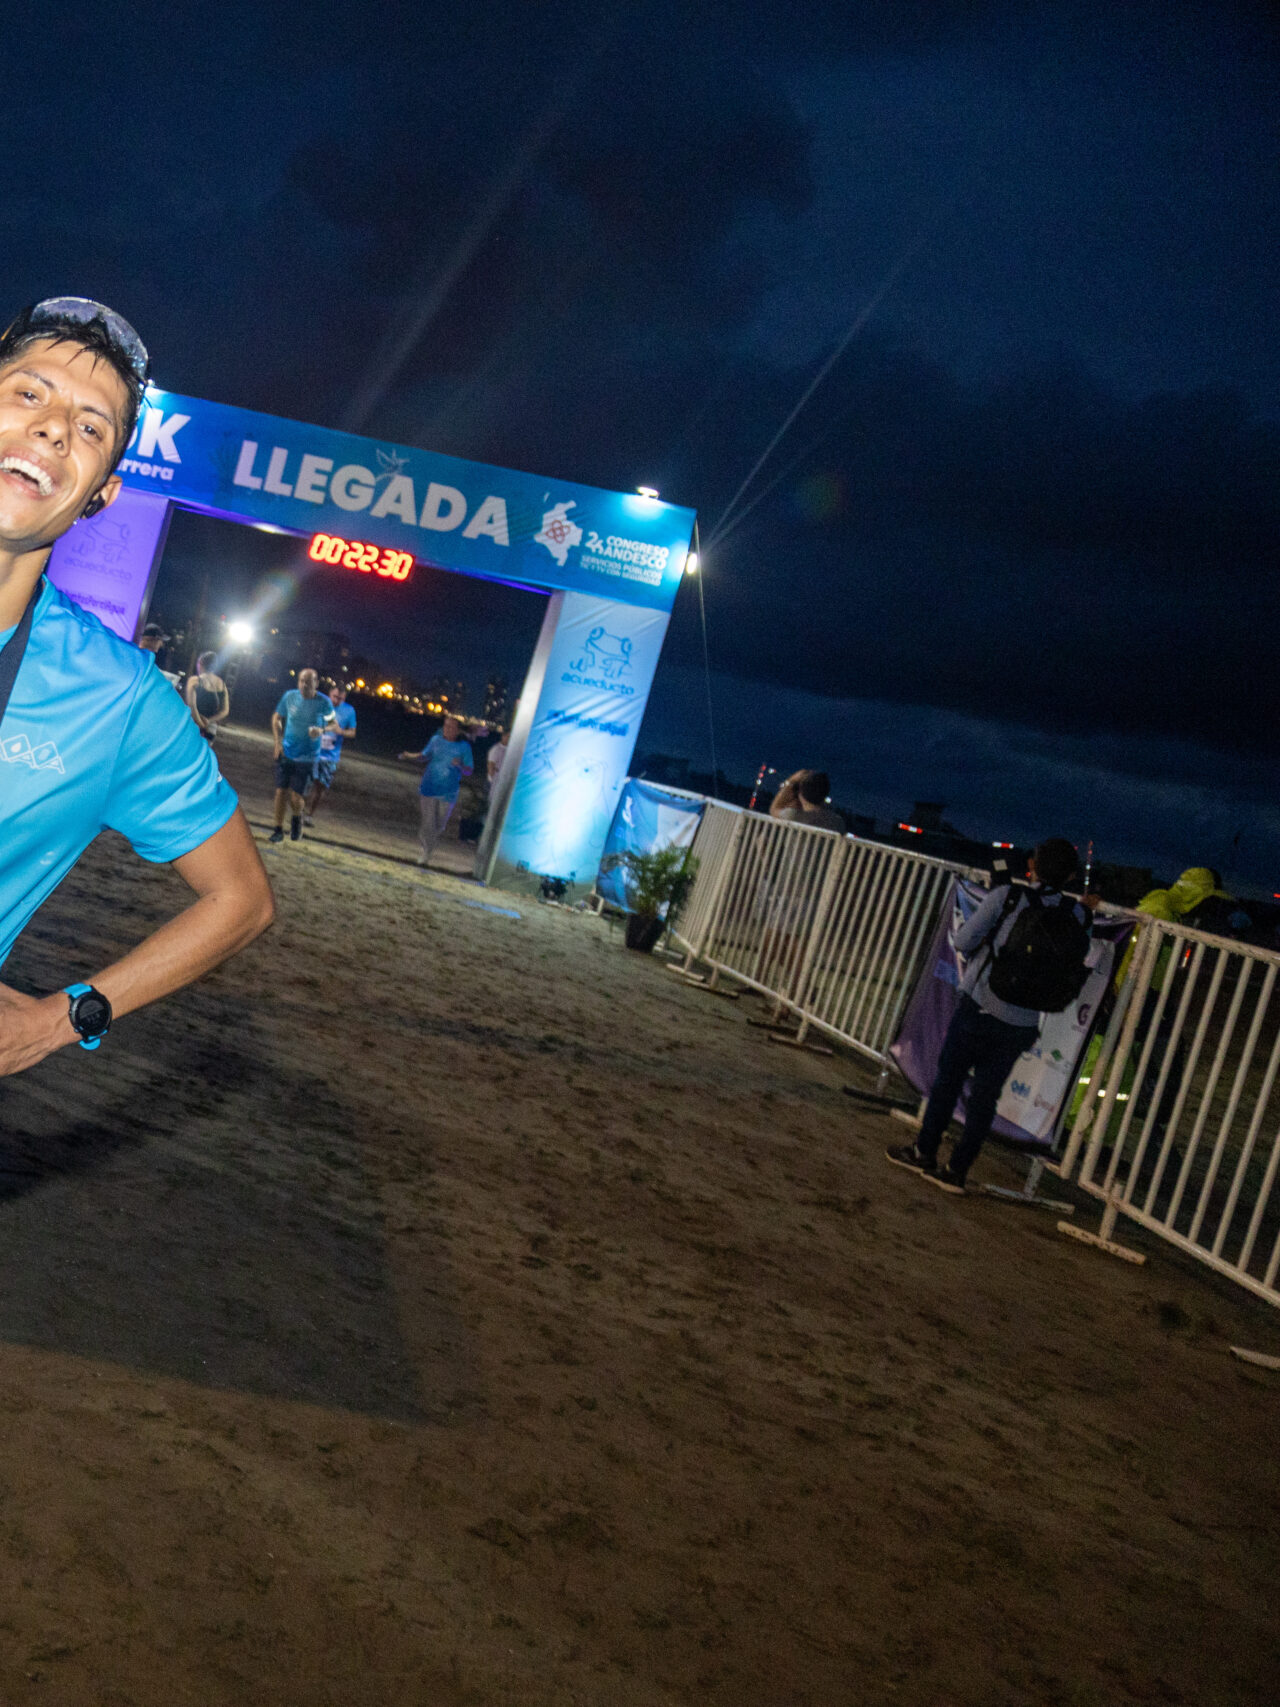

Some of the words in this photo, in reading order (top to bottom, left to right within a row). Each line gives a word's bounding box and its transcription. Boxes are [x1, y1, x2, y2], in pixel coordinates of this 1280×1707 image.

[126, 408, 191, 464] K
[233, 440, 510, 547] LLEGADA
[604, 547, 667, 570] ANDESCO
[606, 536, 669, 558] CONGRESO
[561, 672, 635, 695] acueducto
